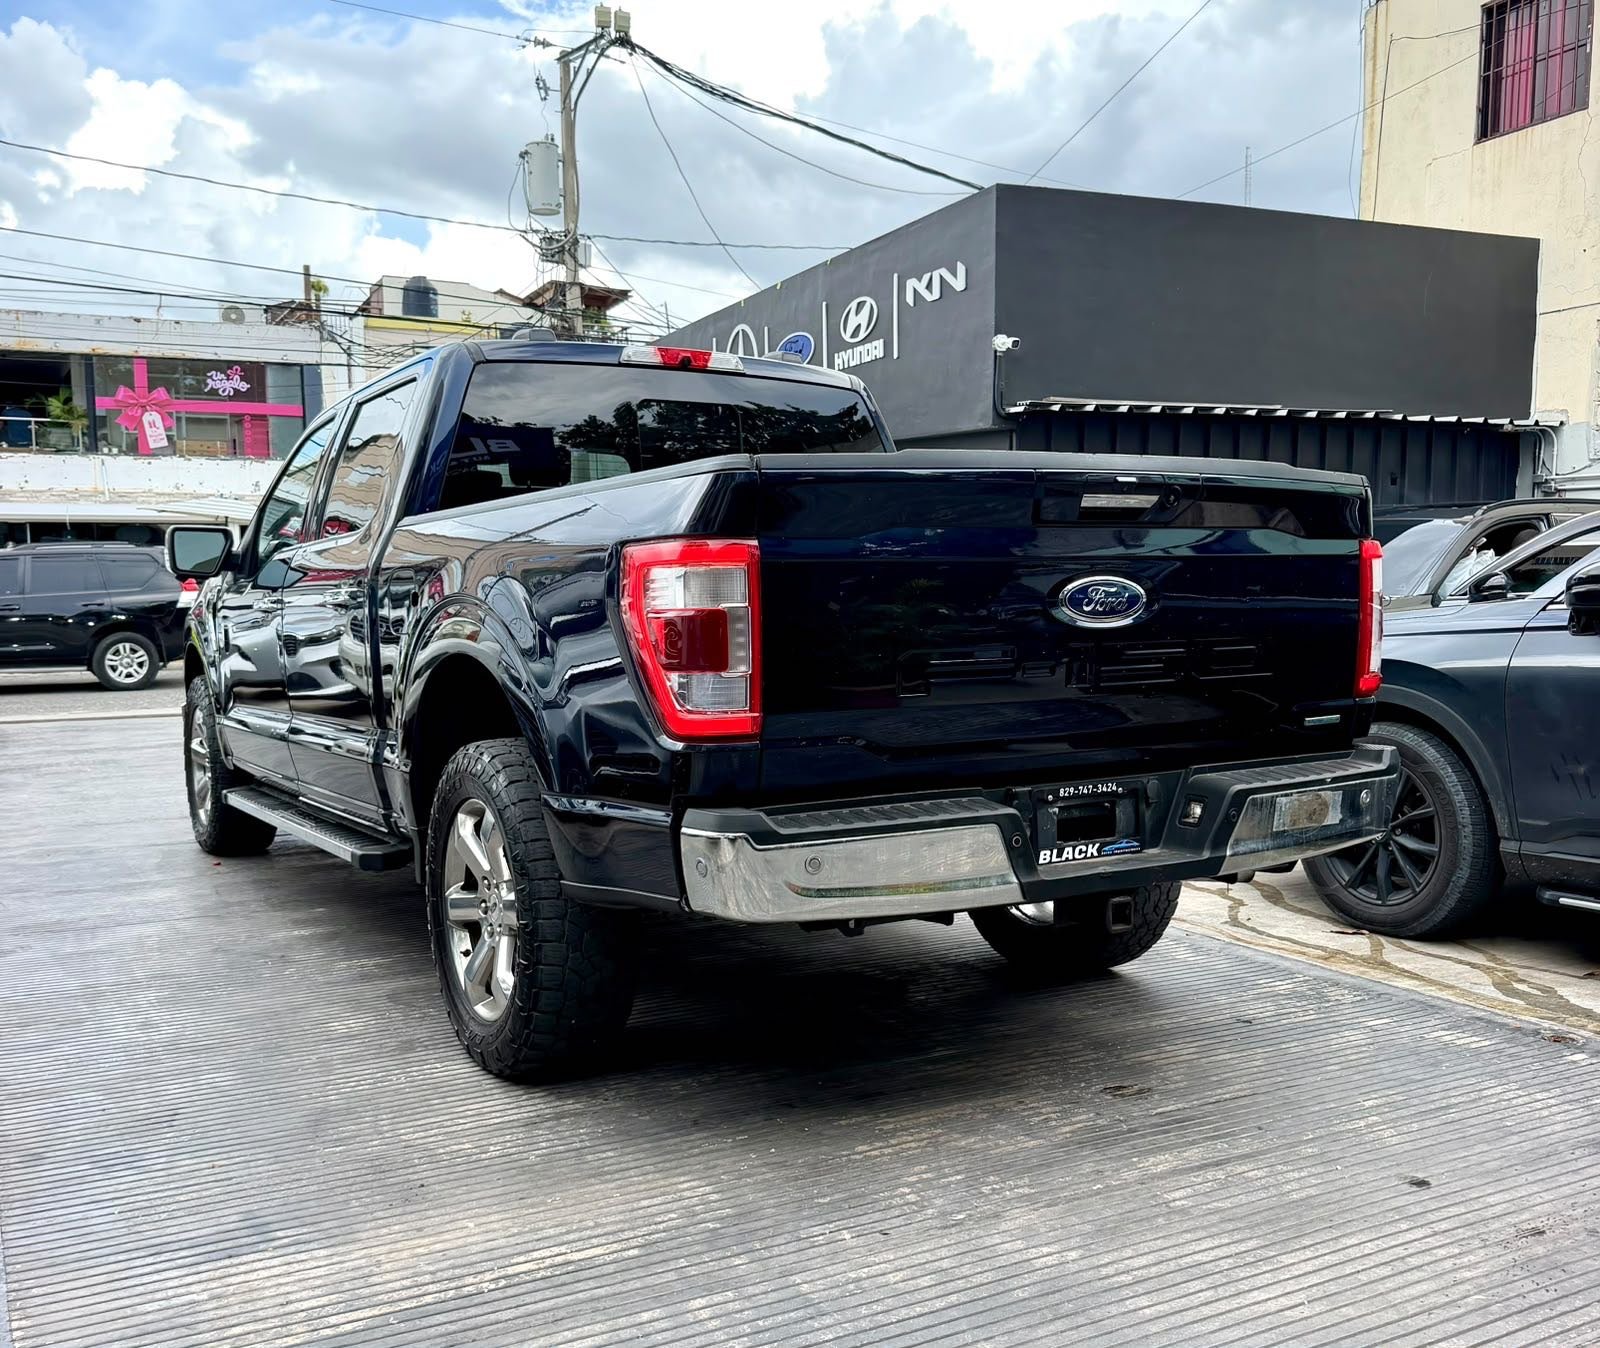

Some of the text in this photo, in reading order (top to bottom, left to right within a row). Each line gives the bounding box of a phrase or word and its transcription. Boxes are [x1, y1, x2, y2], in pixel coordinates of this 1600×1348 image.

[834, 338, 885, 371] HYUNDAI
[1082, 585, 1129, 612] Ford
[1059, 782, 1117, 797] 829-747-3424
[1038, 842, 1100, 865] BLACK
